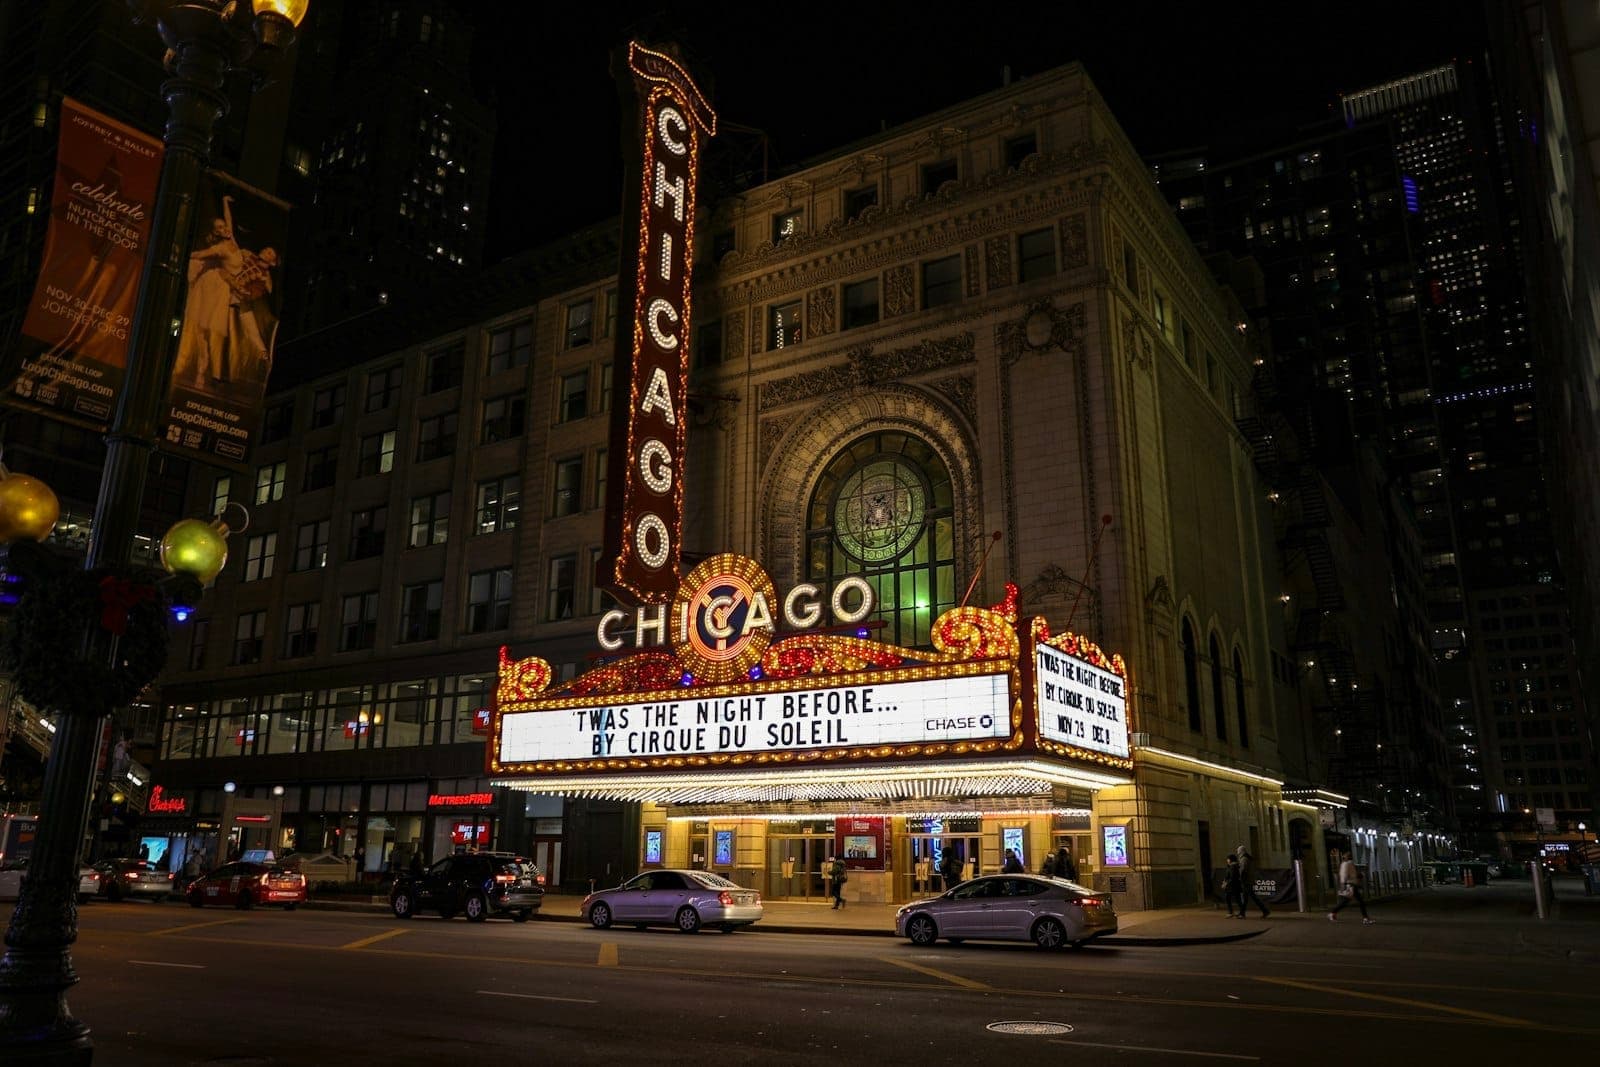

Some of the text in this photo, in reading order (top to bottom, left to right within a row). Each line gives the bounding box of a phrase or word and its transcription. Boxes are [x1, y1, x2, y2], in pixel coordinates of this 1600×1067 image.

[72, 114, 113, 138] JOFFREY
[124, 139, 157, 159] BALLET
[71, 181, 145, 220] celebrate
[96, 203, 117, 220] THE
[66, 211, 138, 250] IN THE LOOP
[67, 201, 140, 241] NUTCRACKER
[46, 284, 73, 302] NOV
[115, 314, 130, 327] 29
[636, 106, 687, 568] CHICAGO
[21, 357, 114, 398] LoopChicago.com
[170, 406, 248, 440] LoopChicago.com
[597, 576, 875, 650] CHICAGO
[1061, 659, 1075, 681] THE
[1076, 666, 1097, 689] NIGHT
[572, 688, 898, 732] 'TWAS THE NIGHT BEFORE...
[1045, 682, 1055, 702] BY
[1058, 687, 1084, 711] CIRQUE
[1086, 697, 1095, 714] DU
[592, 719, 848, 755] BY CIRQUE DU SOLEIL
[926, 717, 977, 731] CHASE
[1057, 714, 1072, 735] NOV
[1092, 725, 1105, 744] DEC
